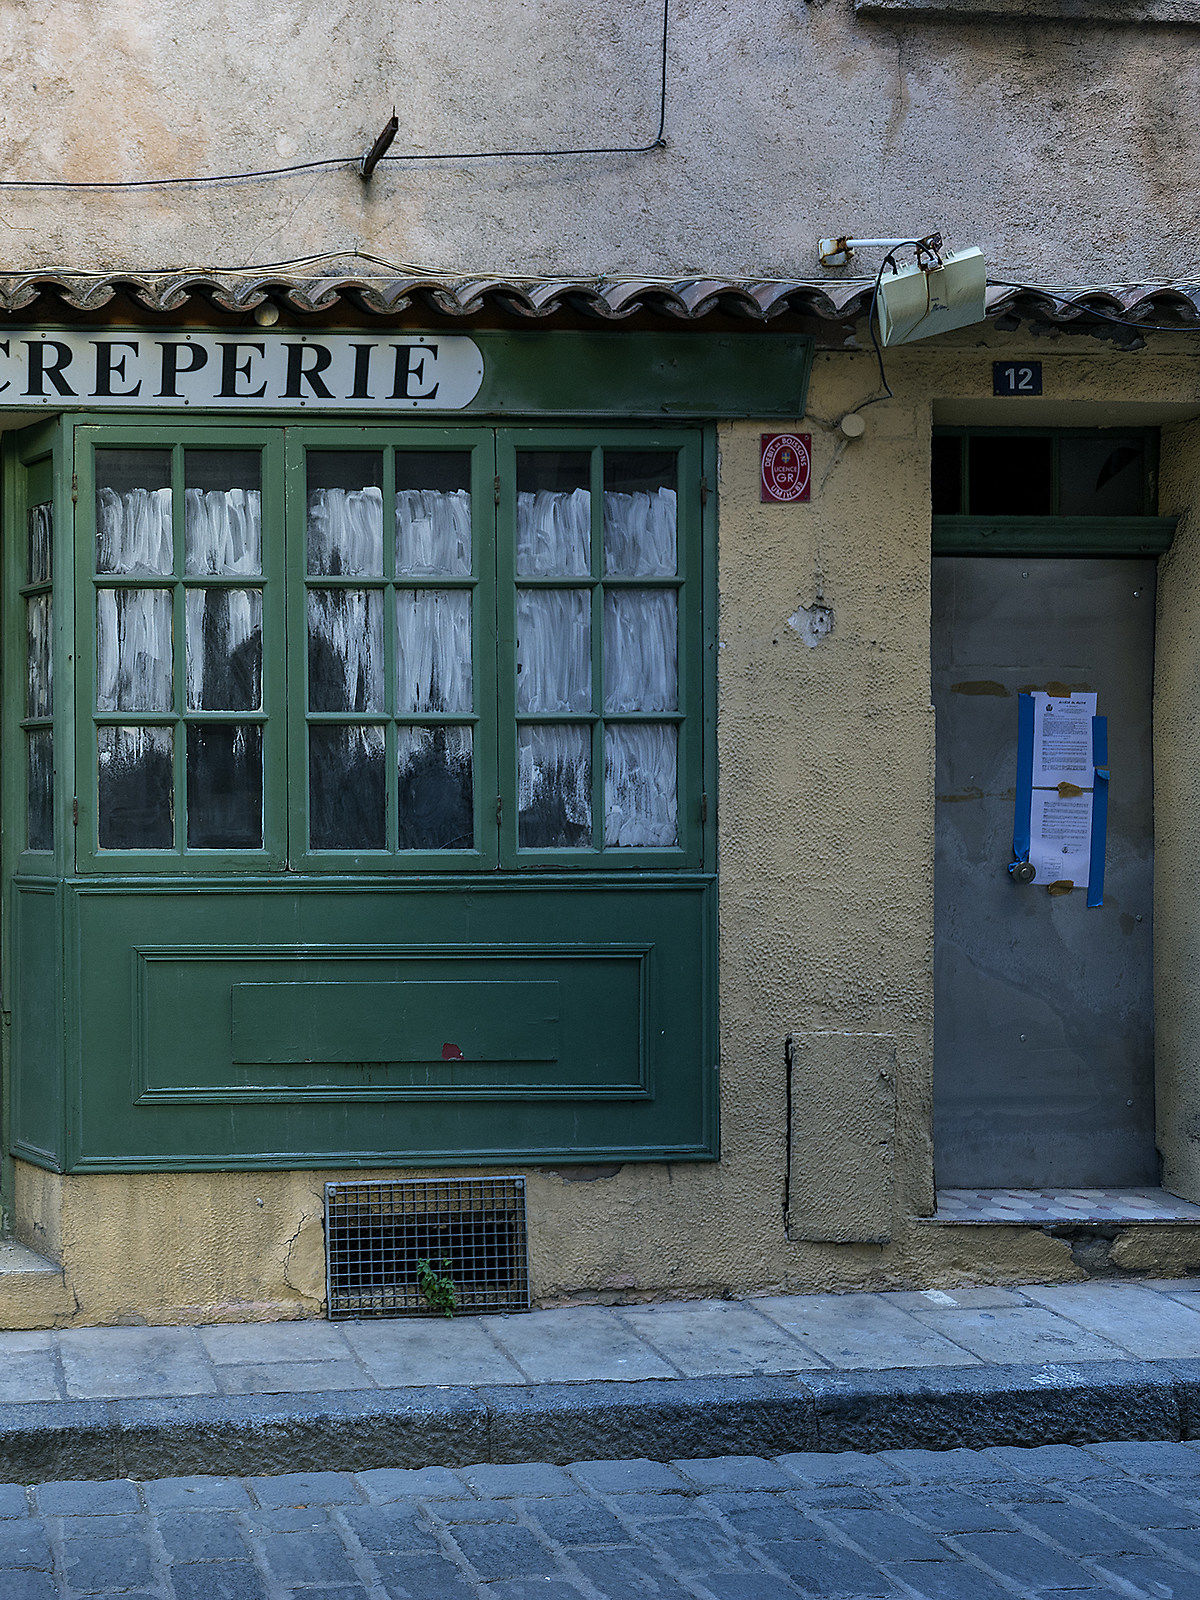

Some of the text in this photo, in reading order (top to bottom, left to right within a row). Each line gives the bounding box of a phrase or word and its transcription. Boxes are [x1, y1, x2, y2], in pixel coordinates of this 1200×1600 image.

[1005, 368, 1033, 390] 12
[782, 438, 807, 467] BOISSONS
[776, 473, 794, 482] GR
